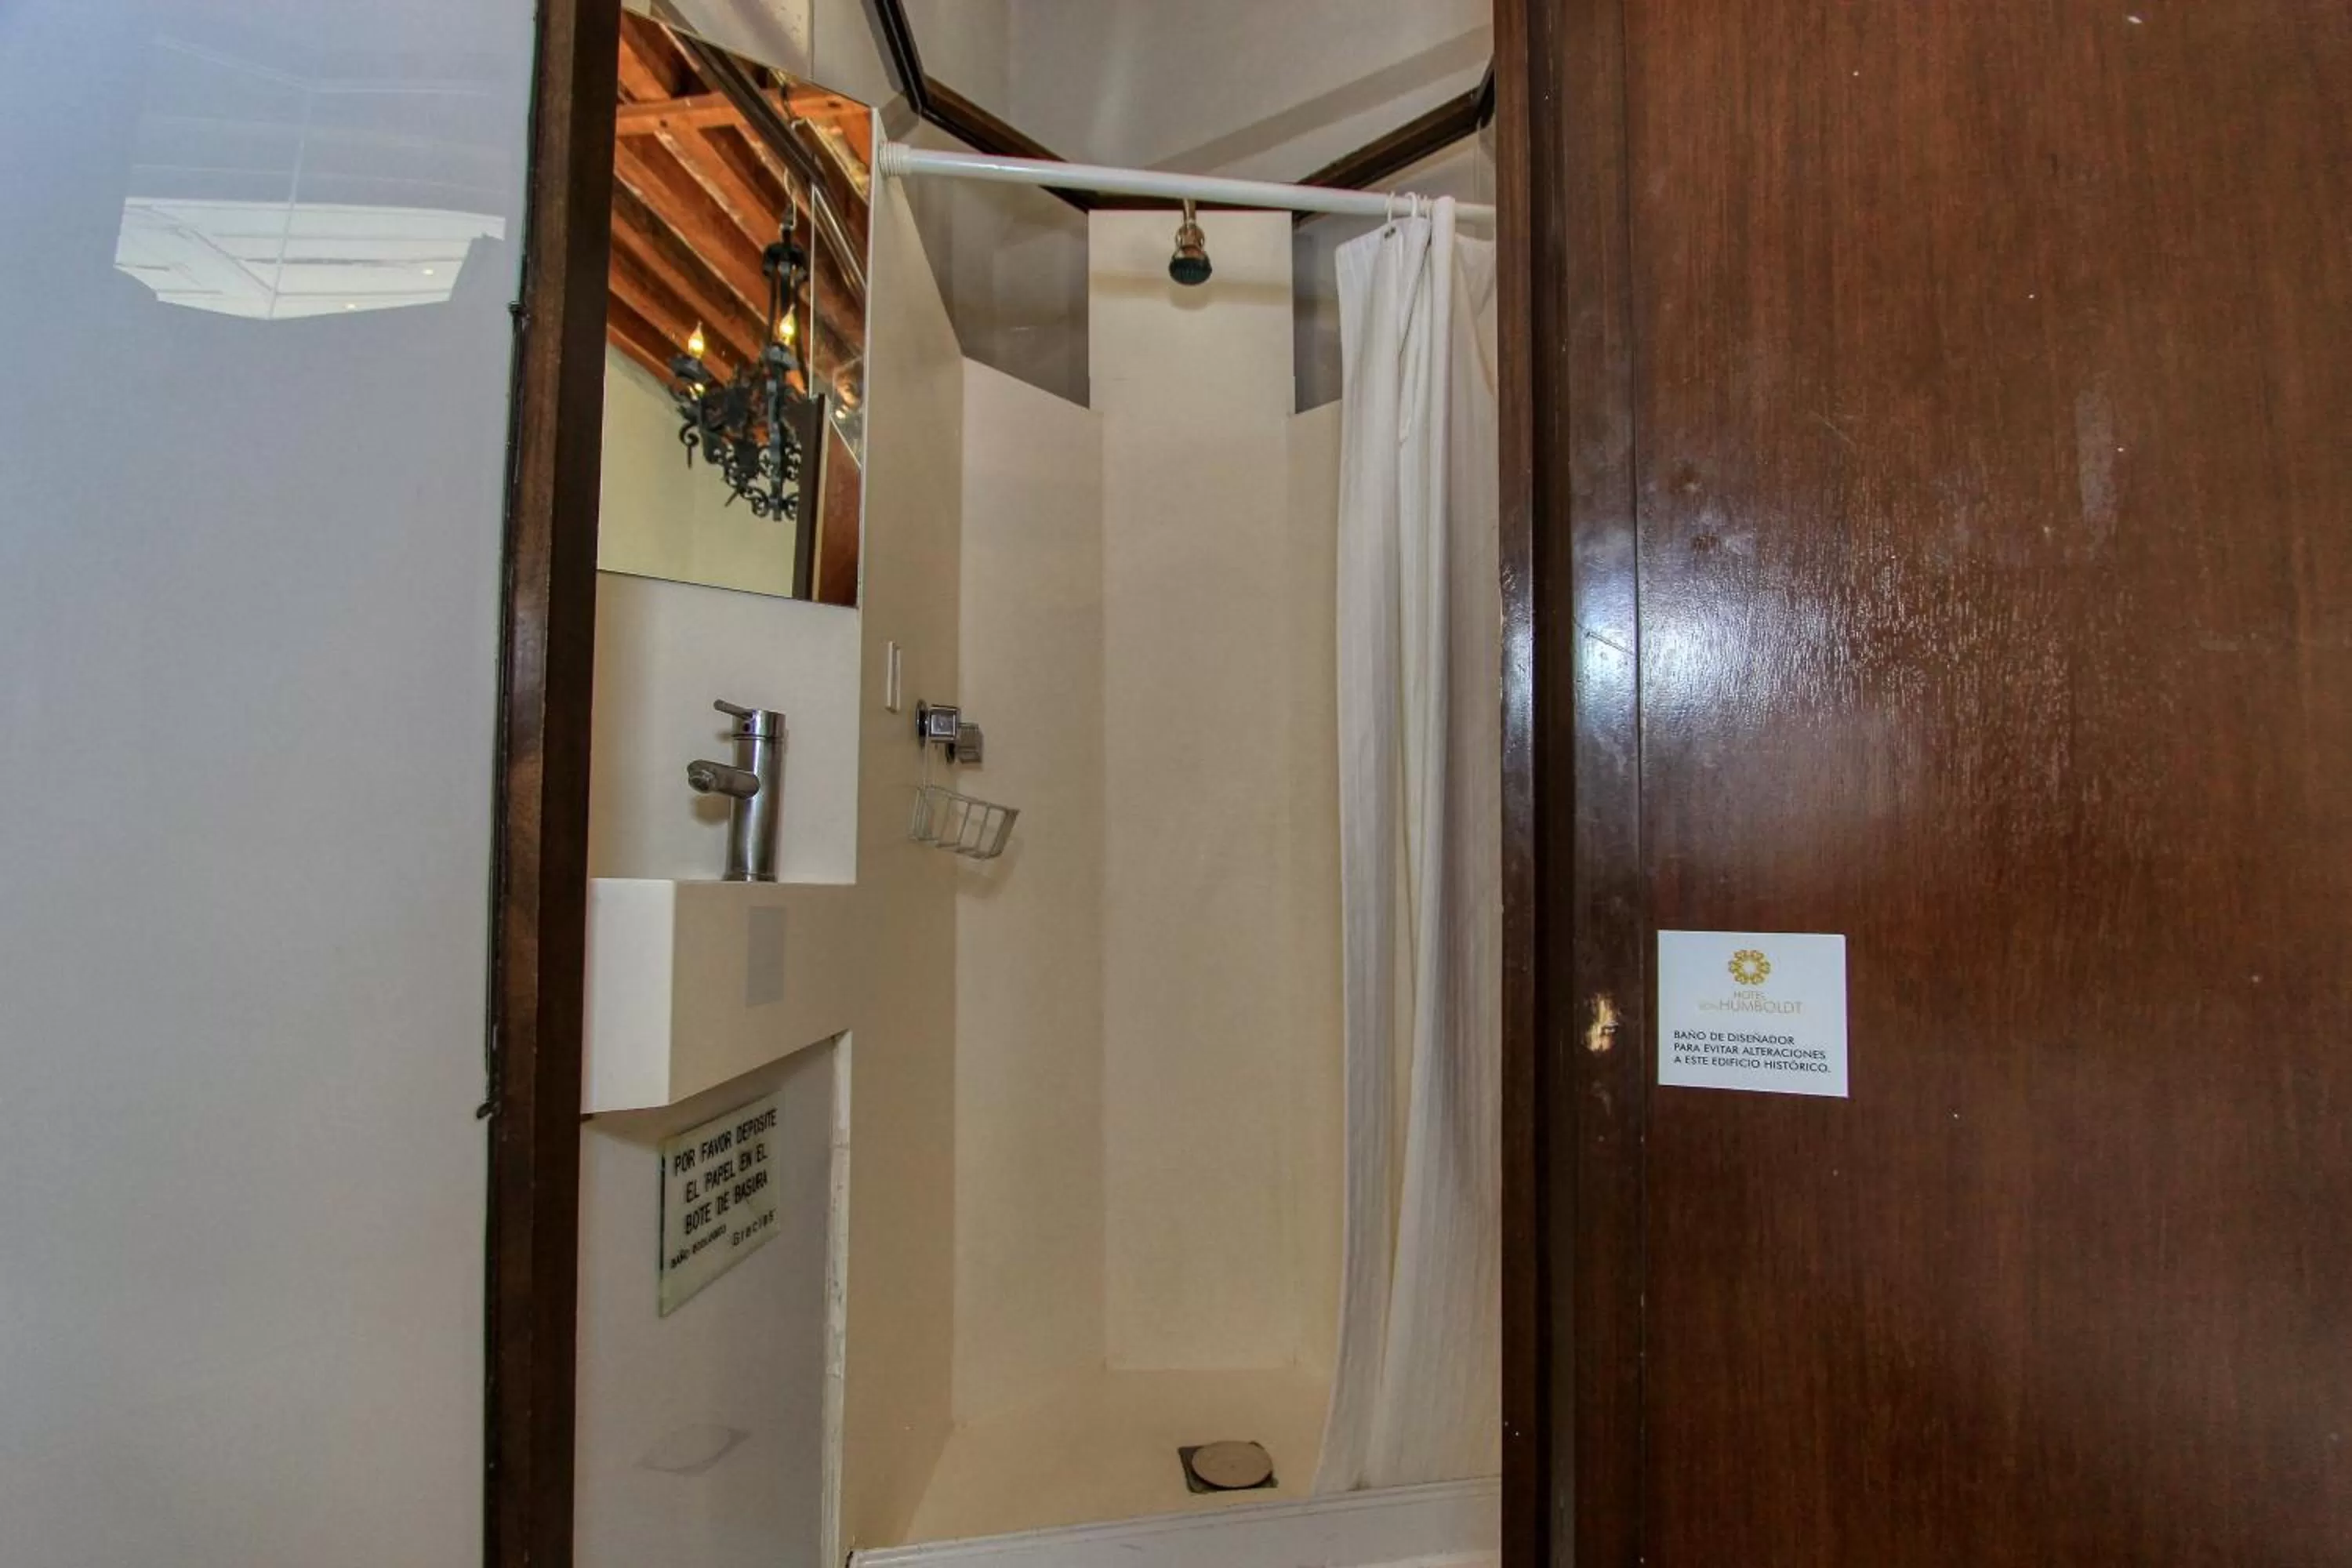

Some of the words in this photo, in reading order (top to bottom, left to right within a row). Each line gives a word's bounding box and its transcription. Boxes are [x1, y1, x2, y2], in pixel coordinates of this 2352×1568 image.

[1674, 1029, 1706, 1040] BAÑO
[1710, 1032, 1724, 1042] DE
[1727, 1032, 1795, 1045] DISEÑADOR
[1674, 1043, 1700, 1053] PARA
[1704, 1044, 1738, 1054] EVITAR
[1742, 1047, 1826, 1060] ALTERACIONES
[1674, 1055, 1682, 1064] A
[1685, 1056, 1708, 1065] ESTE
[1712, 1058, 1760, 1069] EDIFICIO
[1764, 1059, 1831, 1073] HISTÓRICO.
[674, 1149, 695, 1176] POR
[701, 1131, 731, 1163] FAVOR
[736, 1108, 778, 1144] DEPOSITE
[685, 1181, 700, 1203] EL
[704, 1160, 735, 1190] PAPEL
[739, 1152, 753, 1172] EN
[757, 1143, 768, 1162] EL
[684, 1202, 712, 1236] BOTE
[717, 1191, 731, 1215] DE
[734, 1169, 768, 1205] BASURA
